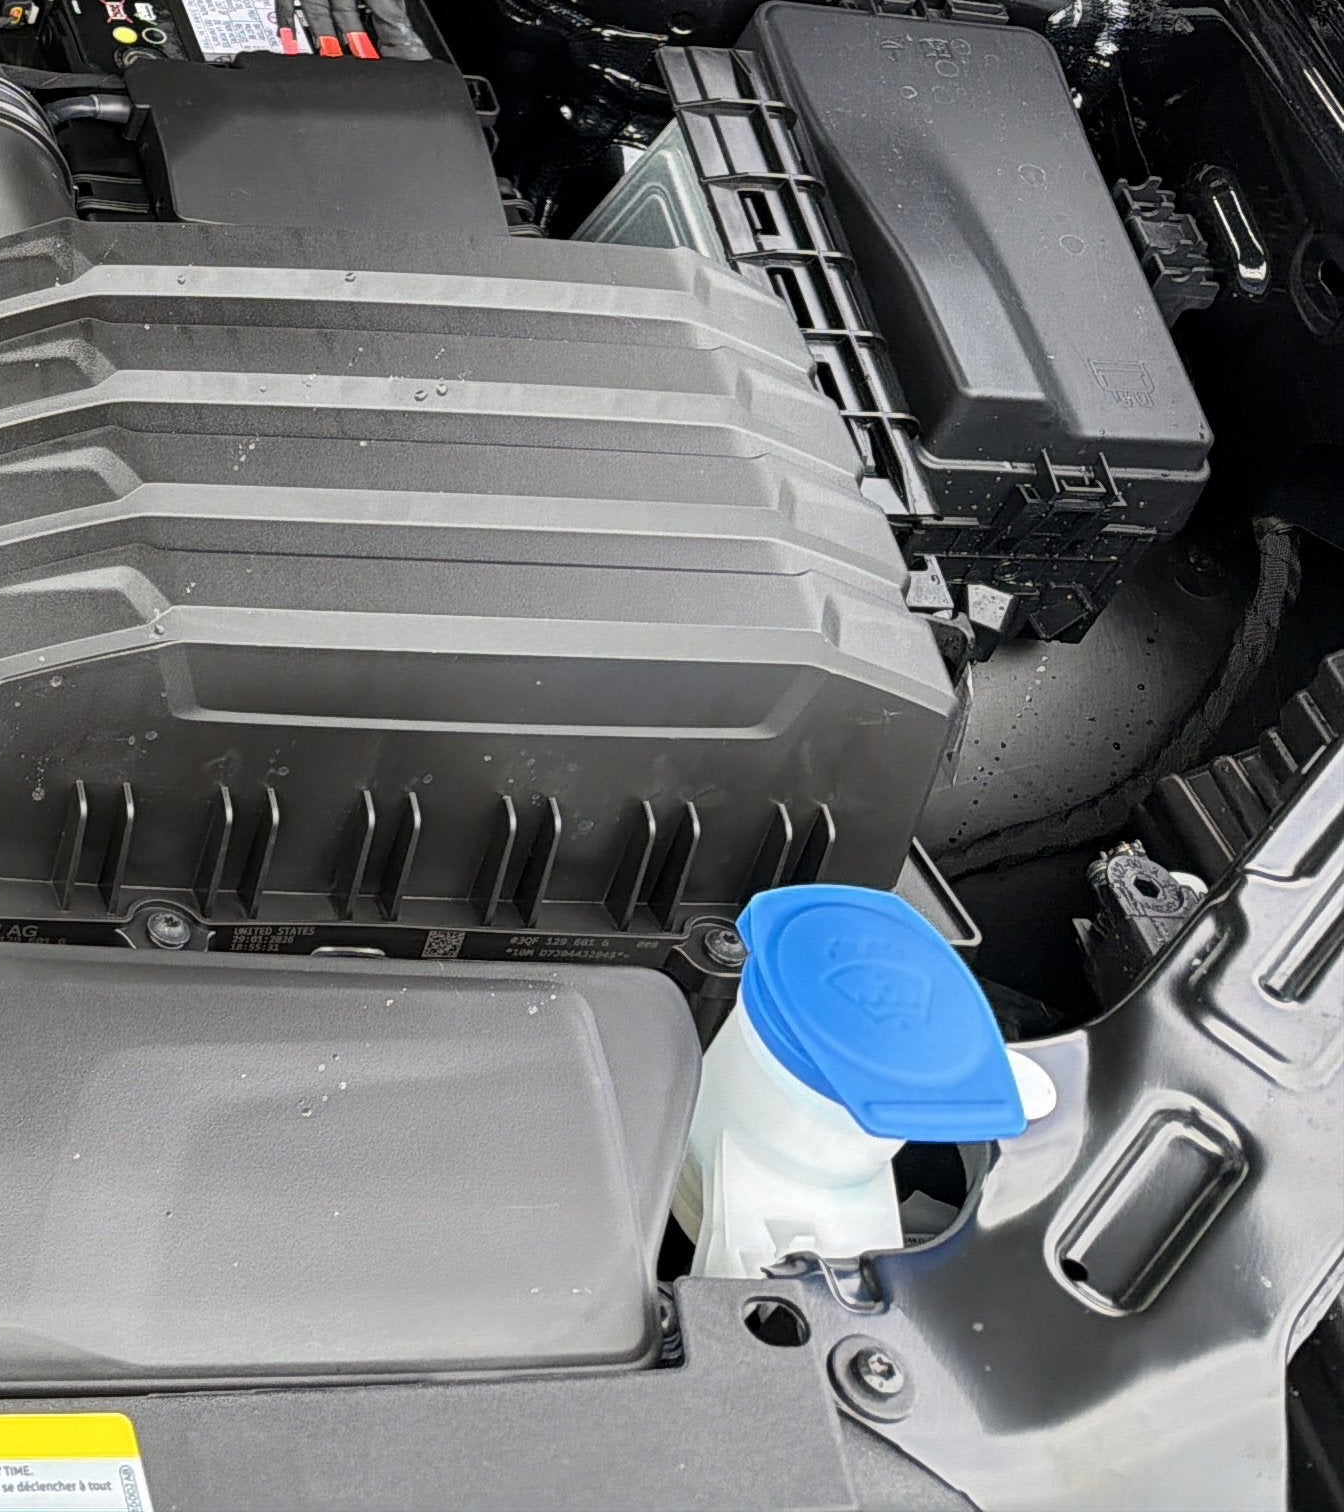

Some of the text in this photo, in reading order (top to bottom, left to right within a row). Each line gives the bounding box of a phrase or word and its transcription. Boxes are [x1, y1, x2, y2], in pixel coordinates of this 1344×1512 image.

[6, 924, 39, 938] AG
[234, 927, 316, 936] UNITED STATES
[5, 1464, 35, 1476] TIME.
[1, 1483, 15, 1493] se
[16, 1479, 77, 1493] déclencher
[78, 1479, 86, 1492] à
[88, 1480, 113, 1492] tout
